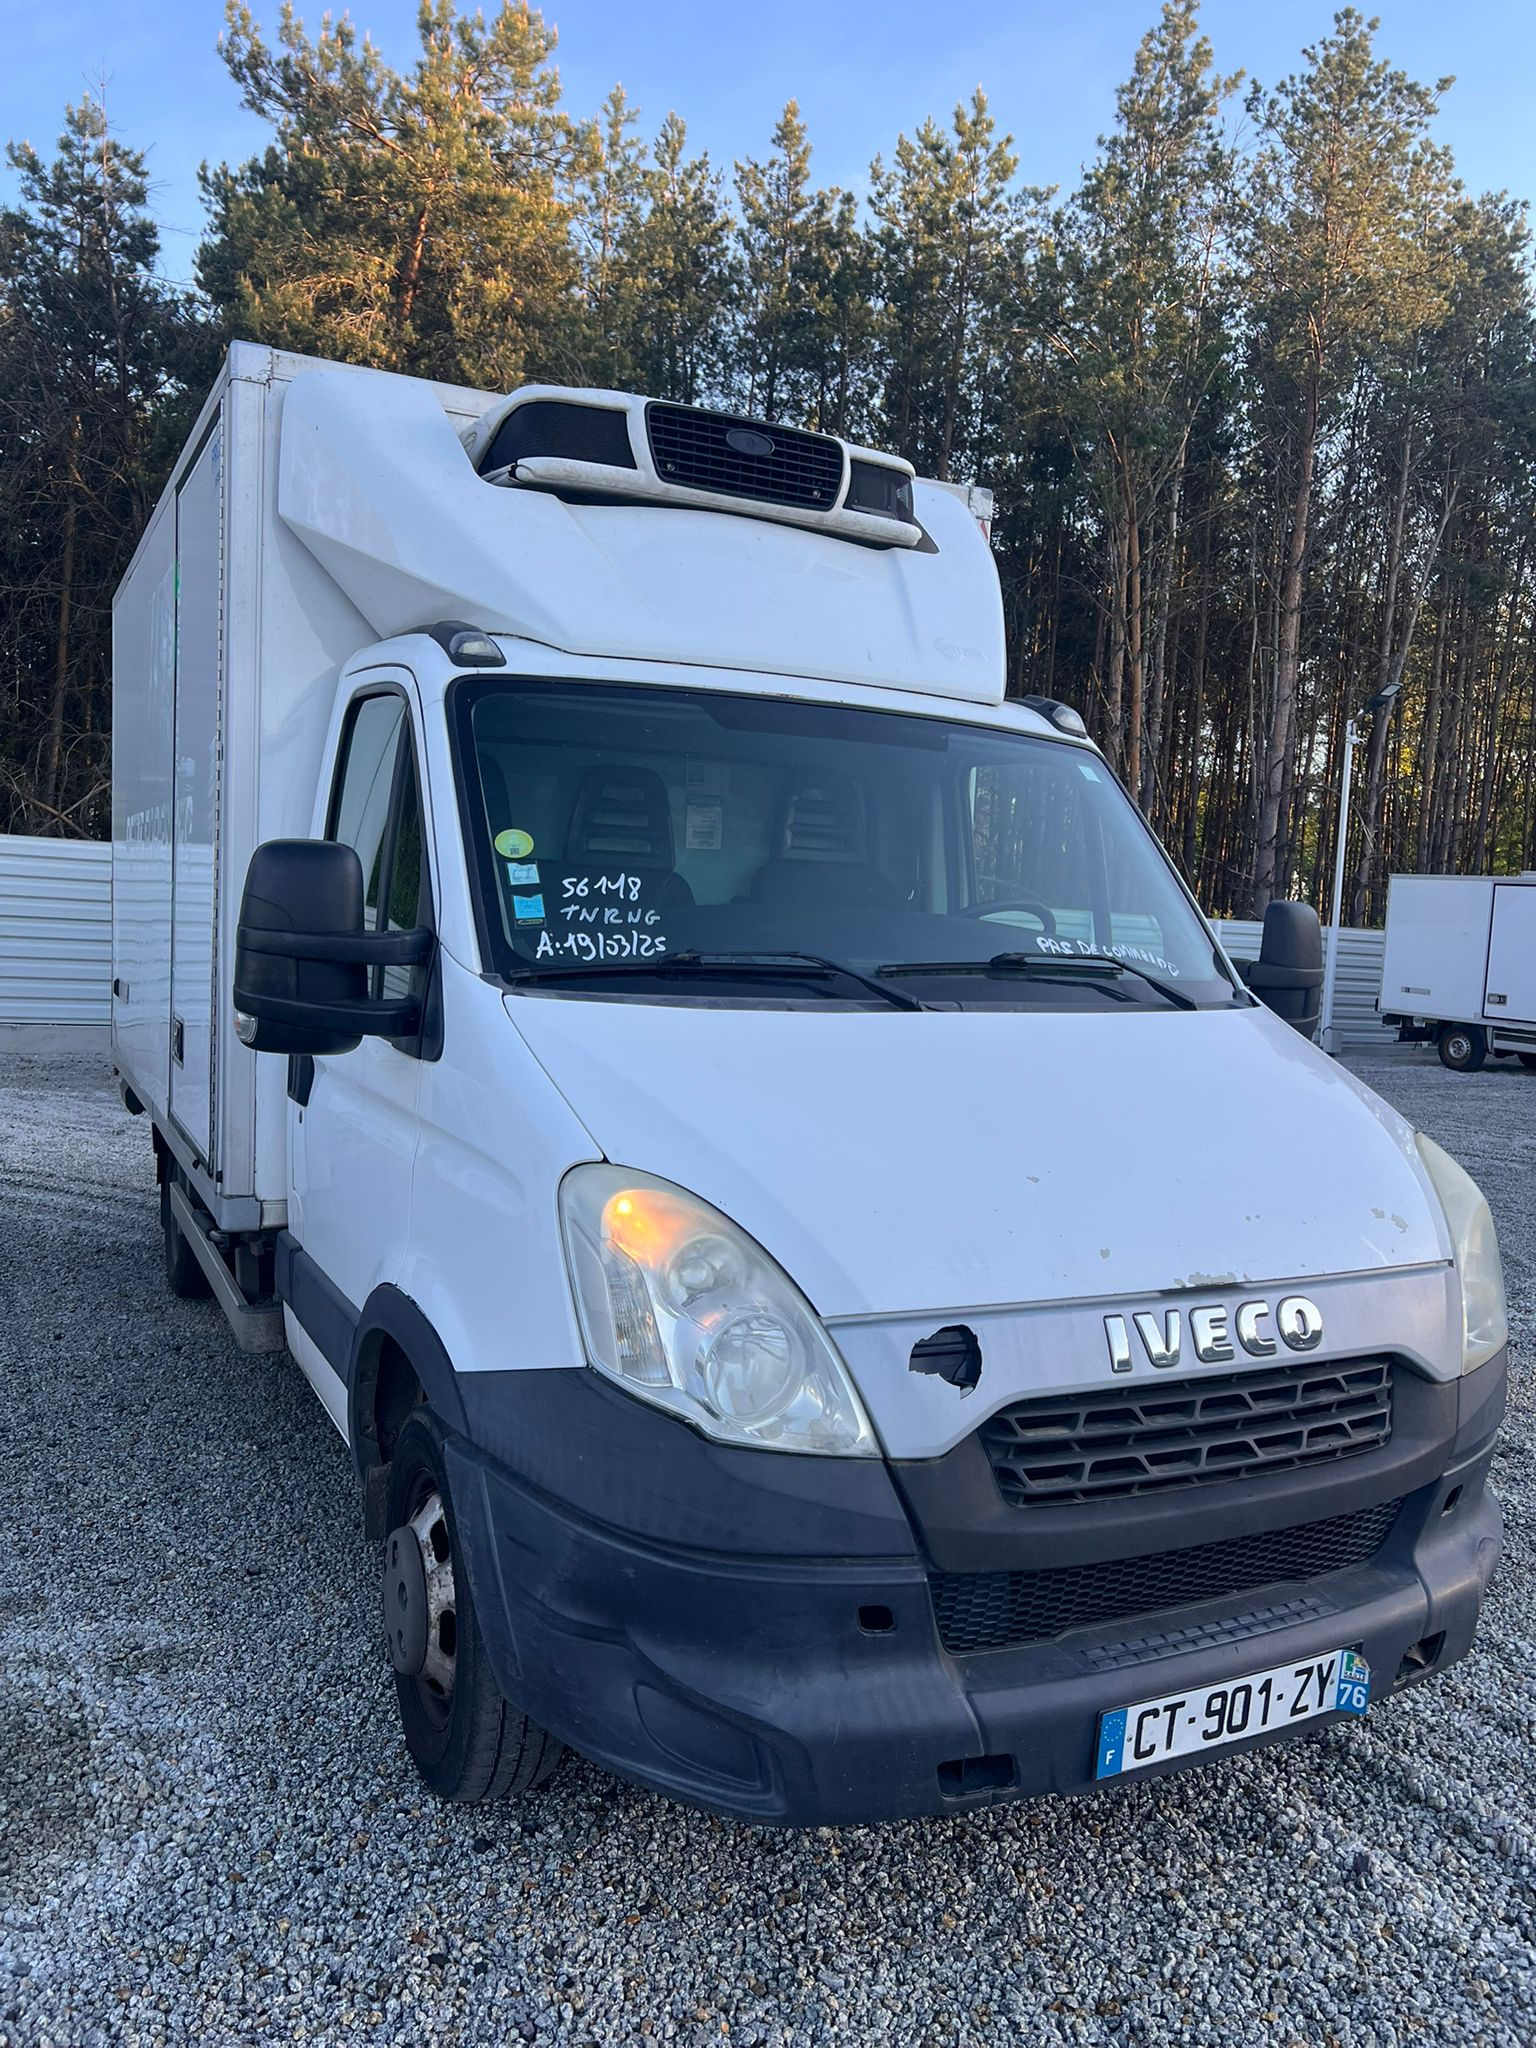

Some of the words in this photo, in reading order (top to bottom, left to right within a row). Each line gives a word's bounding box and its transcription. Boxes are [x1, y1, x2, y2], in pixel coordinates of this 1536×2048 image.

[1036, 936, 1074, 955] PAS
[1076, 939, 1101, 955] DE
[1103, 1295, 1323, 1373] IVECO
[1105, 1749, 1116, 1766] F
[1133, 1659, 1336, 1761] CT-901-ZY
[1339, 1682, 1367, 1709] 76
